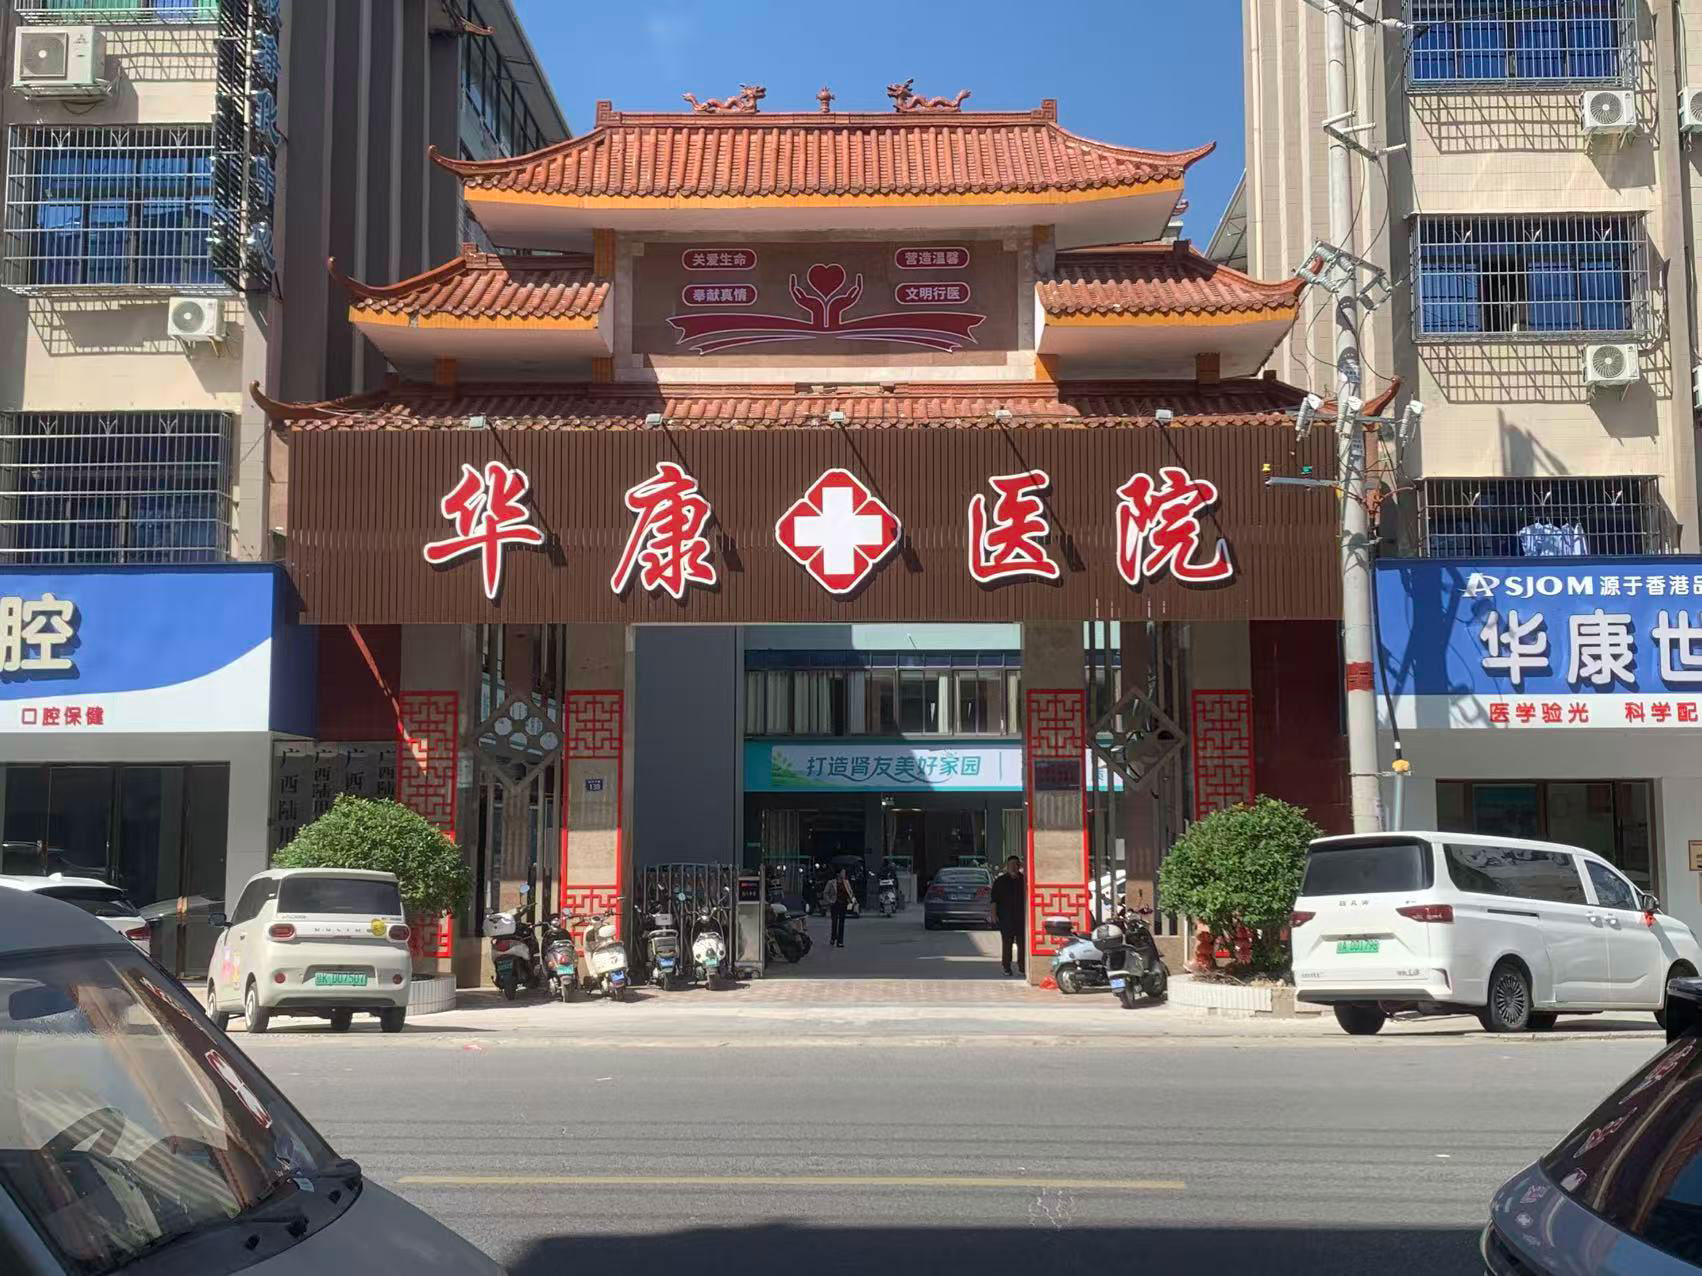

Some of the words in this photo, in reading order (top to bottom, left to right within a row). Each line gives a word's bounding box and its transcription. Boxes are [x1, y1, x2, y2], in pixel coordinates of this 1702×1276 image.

[692, 252, 747, 266] 关爱生命
[905, 251, 959, 265] 营造温馨
[692, 287, 747, 302] 奉献真情
[905, 286, 961, 300] 文明行医
[21, 706, 105, 726] 口腔保健
[1490, 702, 1590, 724] 医学验光
[1624, 702, 1699, 723] 科学配
[806, 756, 981, 779] 打造肾友美好家园
